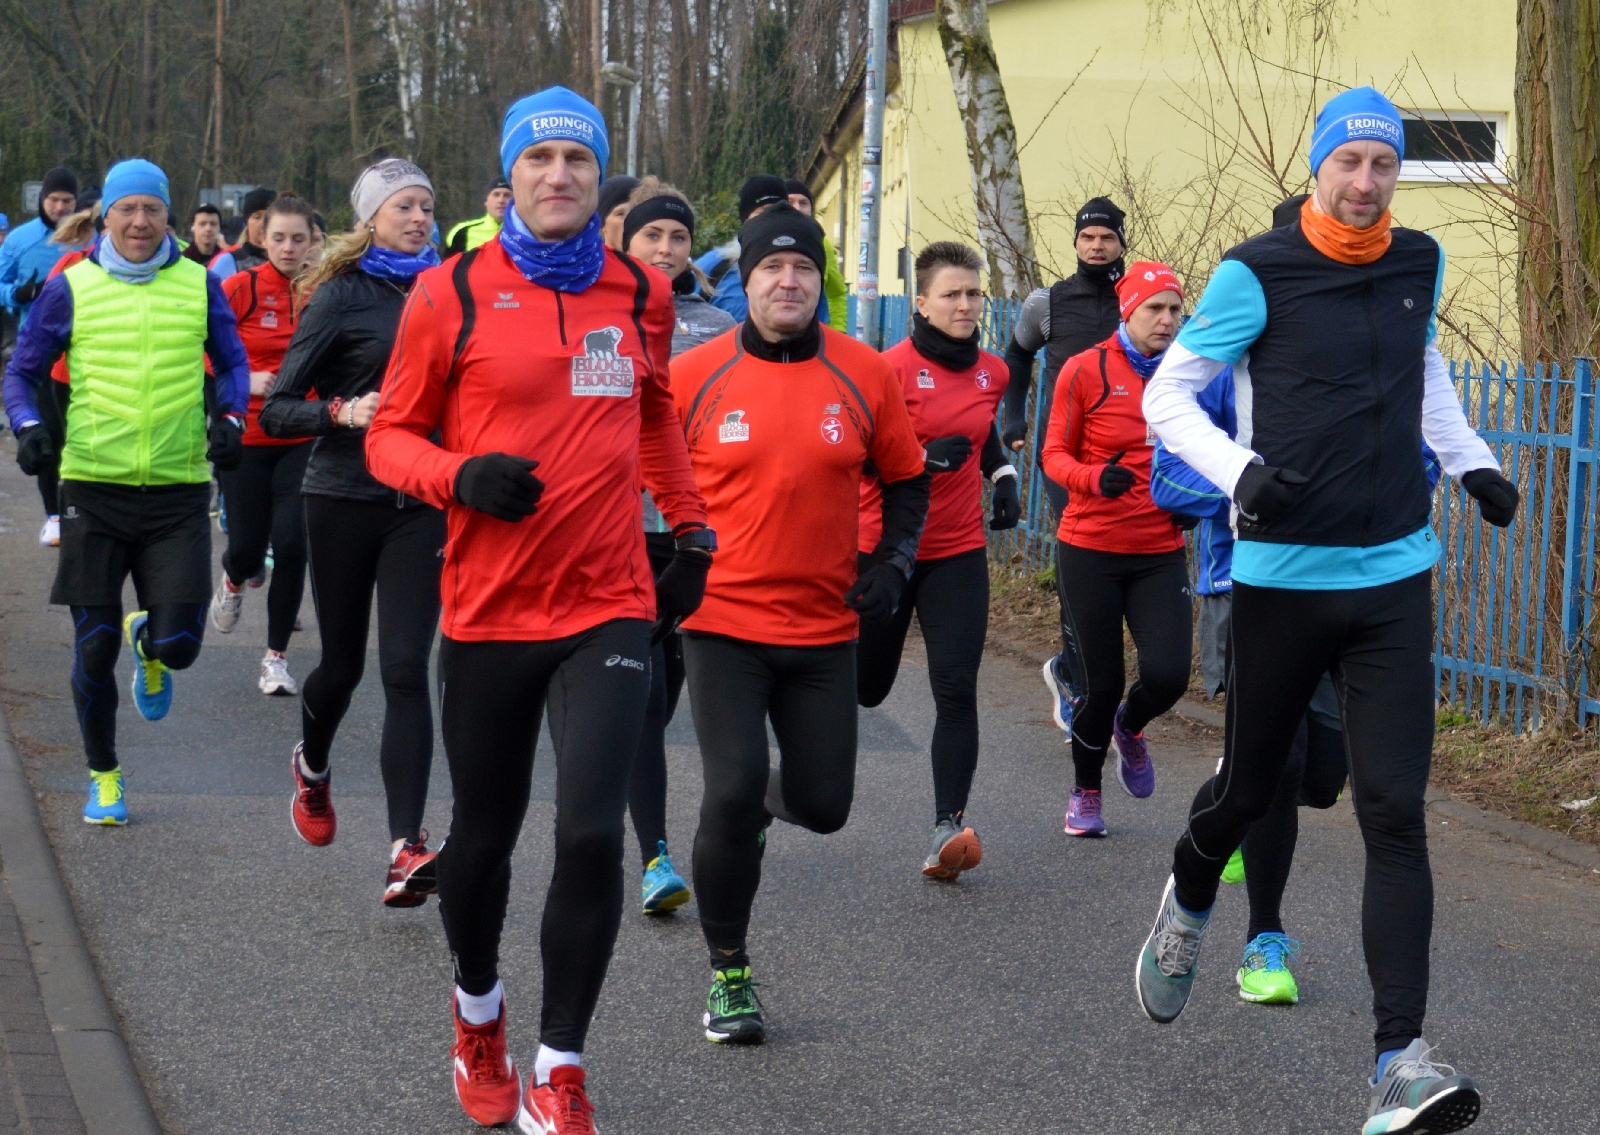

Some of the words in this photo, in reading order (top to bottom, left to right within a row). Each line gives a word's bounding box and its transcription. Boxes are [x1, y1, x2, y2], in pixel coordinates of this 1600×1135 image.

[532, 116, 594, 137] ERDINGER
[1347, 118, 1400, 137] ERDINGER
[1348, 129, 1399, 141] ALKOHOLF
[574, 358, 633, 373] BLOCK
[574, 373, 634, 387] HOUSE
[621, 658, 644, 671] asics
